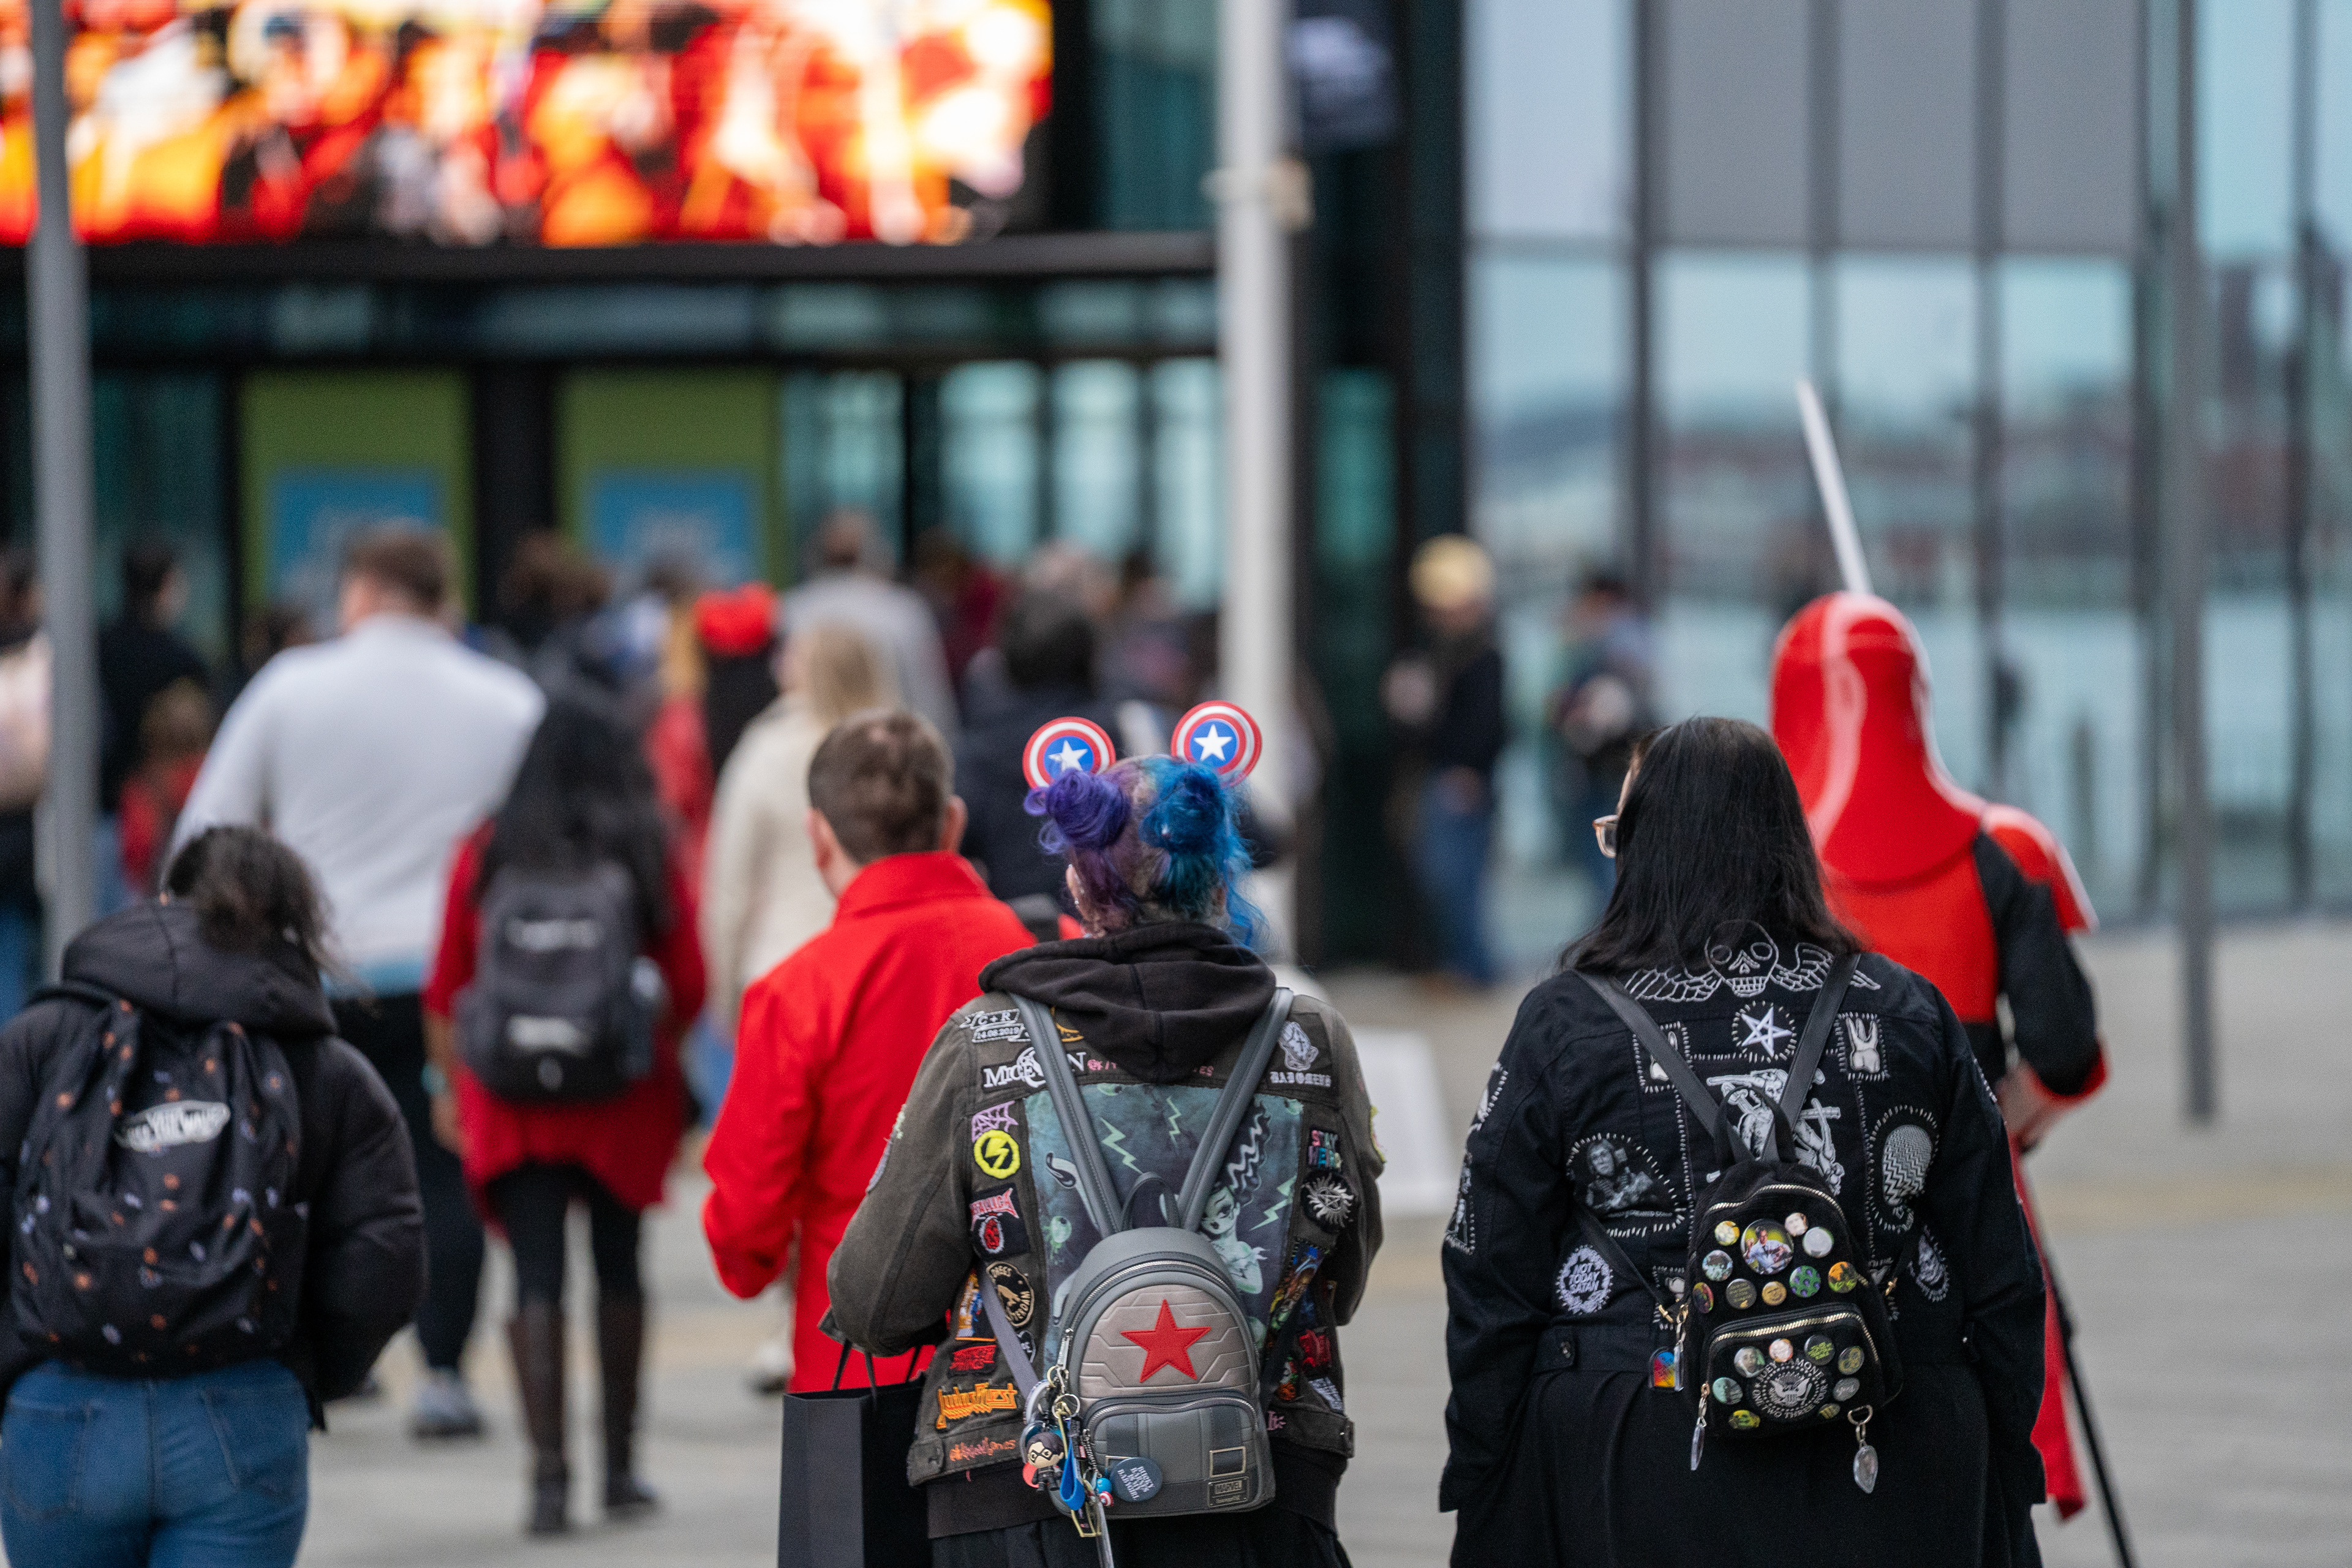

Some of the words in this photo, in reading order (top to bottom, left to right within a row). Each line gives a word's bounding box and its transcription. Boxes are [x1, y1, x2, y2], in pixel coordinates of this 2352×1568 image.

[1001, 1012, 1011, 1021] R
[1569, 1272, 1600, 1286] TODAY
[1572, 1263, 1593, 1275] NOT
[1570, 1281, 1599, 1294] SATAN
[1781, 1358, 1824, 1381] AMONE
[1752, 1389, 1765, 1407] ONE
[1762, 1404, 1783, 1419] TWO
[1117, 1469, 1140, 1501] BABYGIRL
[1130, 1468, 1150, 1493] BARNES
[1137, 1466, 1156, 1488] BUCKY
